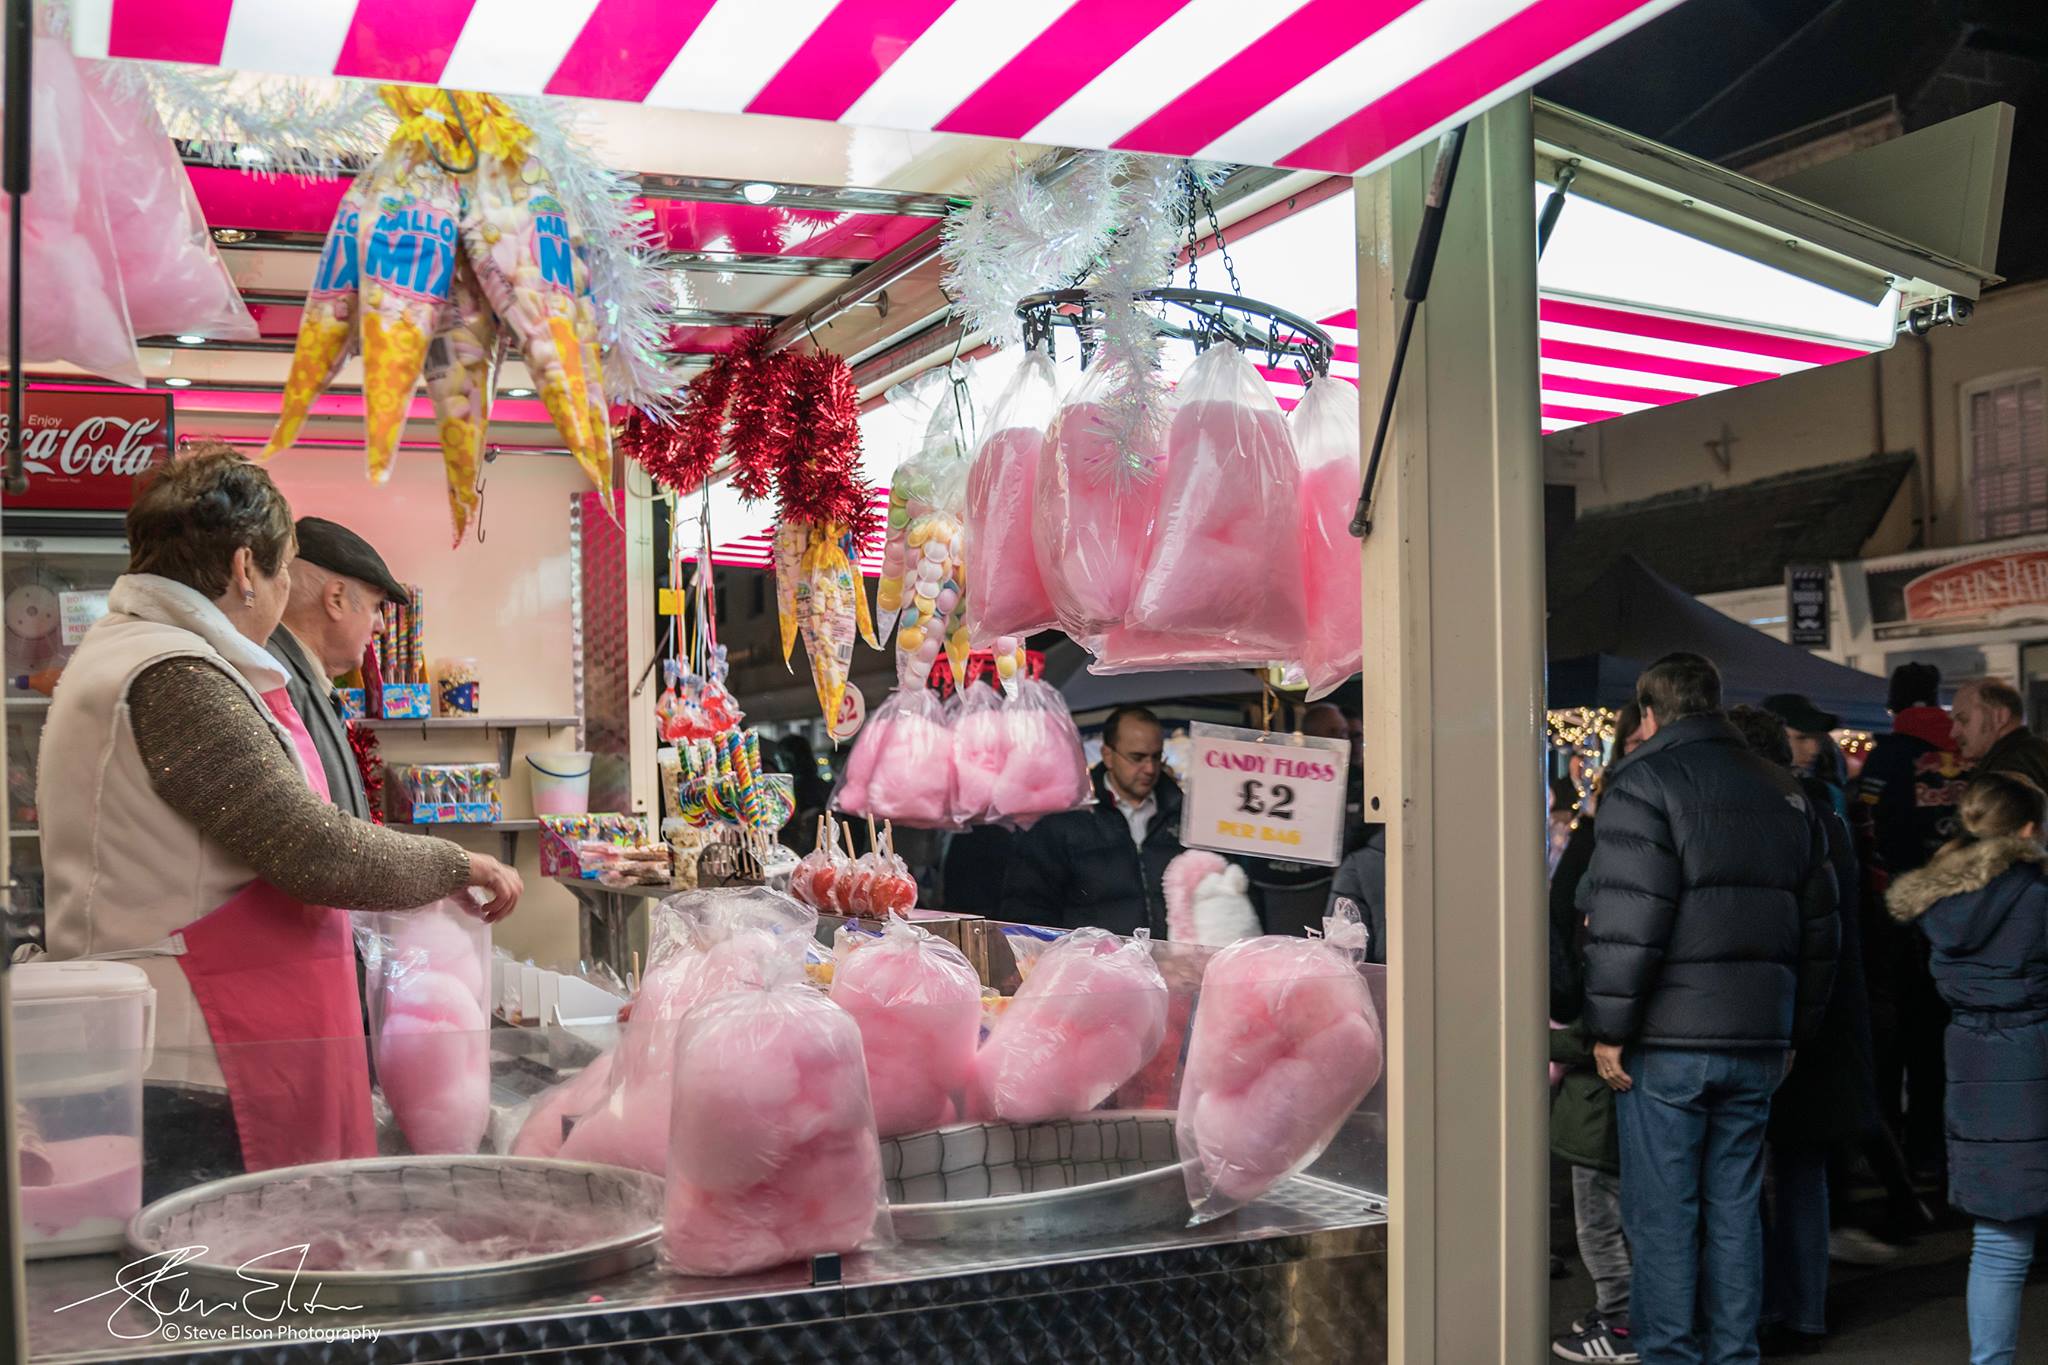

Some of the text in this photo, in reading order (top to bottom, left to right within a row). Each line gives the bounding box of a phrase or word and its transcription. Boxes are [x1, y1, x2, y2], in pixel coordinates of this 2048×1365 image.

[375, 209, 455, 243] MALLO
[365, 231, 456, 300] MIX
[28, 415, 62, 426] Enjoy
[1205, 749, 1335, 782] CANDY FLOSS
[1236, 779, 1295, 820] £2
[1216, 819, 1301, 846] PER BAG
